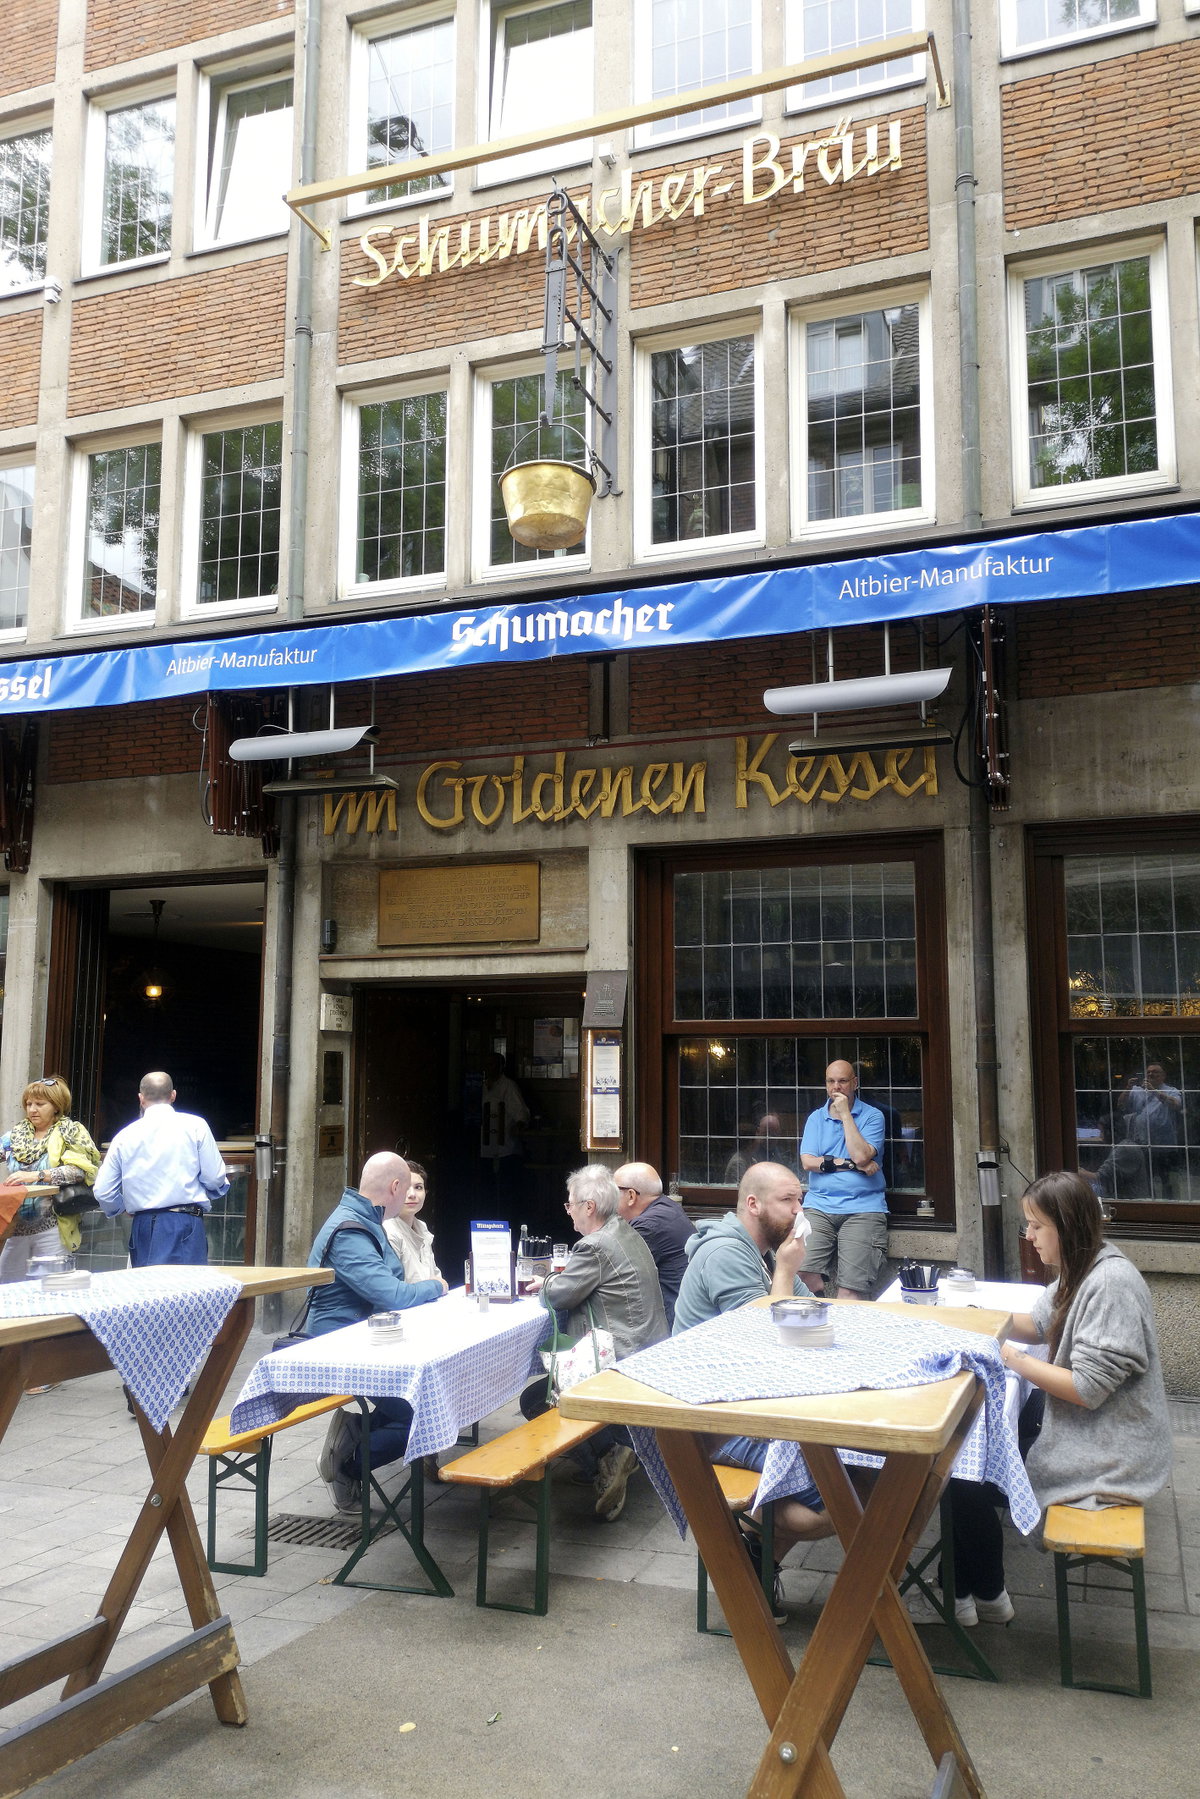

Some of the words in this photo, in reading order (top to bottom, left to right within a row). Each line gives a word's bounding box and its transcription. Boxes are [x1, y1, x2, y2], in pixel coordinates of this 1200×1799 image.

[839, 555, 1054, 600] Altbier-Manufaktur
[450, 597, 676, 652] Schumacher
[166, 648, 318, 676] Altbier-Manufaktur
[417, 752, 708, 829] Goldenen
[735, 718, 939, 808] Kessel
